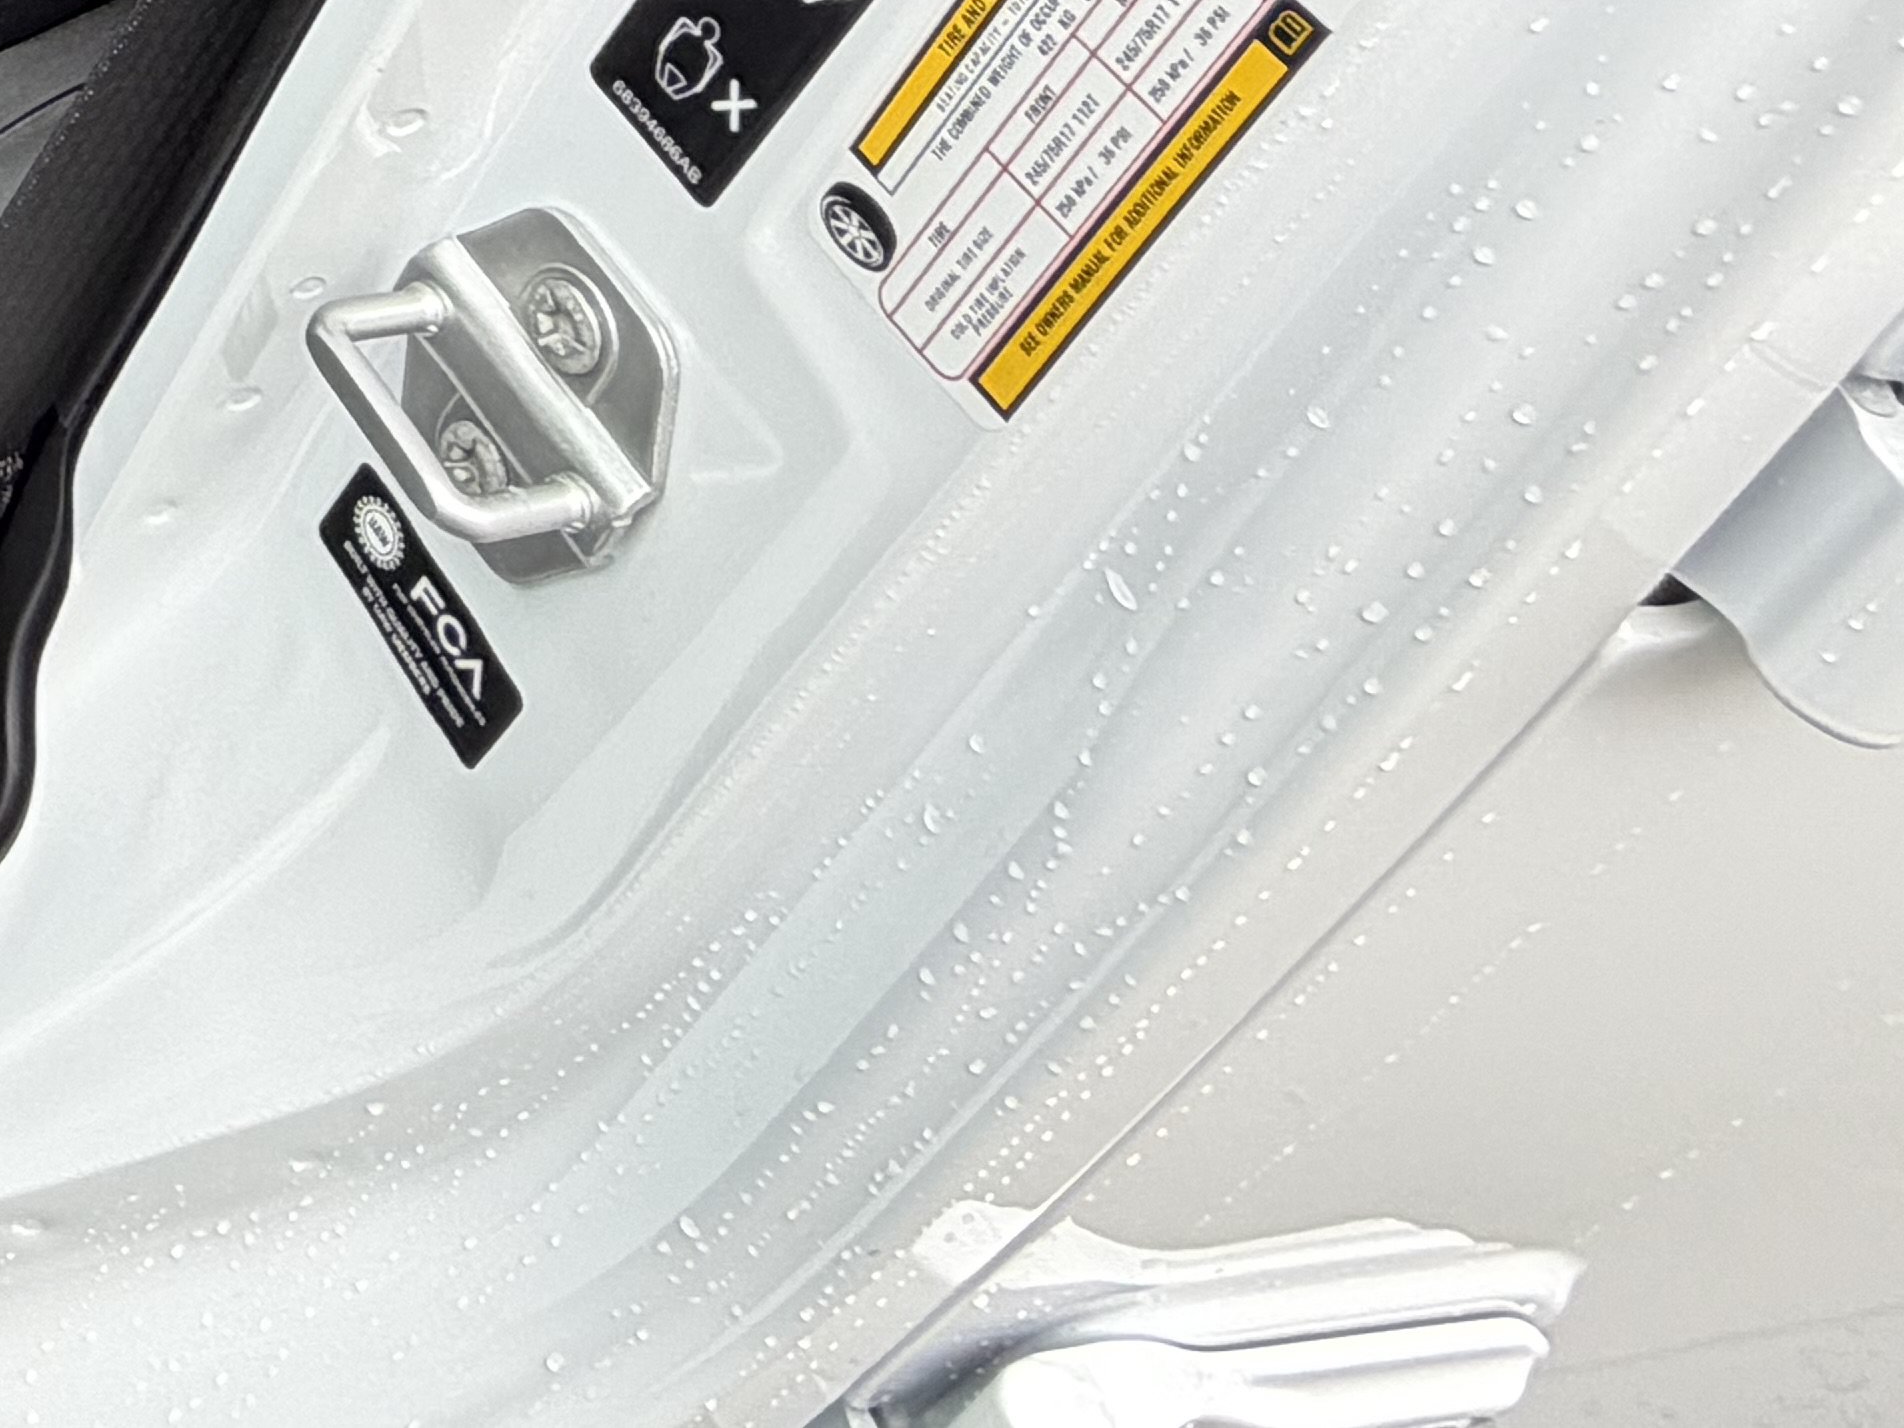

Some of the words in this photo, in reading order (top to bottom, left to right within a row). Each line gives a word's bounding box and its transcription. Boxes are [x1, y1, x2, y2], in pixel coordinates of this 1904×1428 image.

[937, 23, 967, 57] TIRE
[1114, 4, 1170, 72] 245/75R17
[930, 137, 953, 161] THE
[947, 85, 992, 141] COMBINED
[986, 44, 1023, 87] WEIGHT
[1018, 28, 1034, 48] OF
[927, 221, 952, 248] TIRE
[1019, 331, 1042, 357] SEE
[1068, 249, 1111, 294] MANUAL
[1103, 224, 1129, 252] FOR
[1122, 166, 1180, 230] ADDITIONAL
[1172, 90, 1242, 169] INFORMATION
[409, 575, 484, 701] FCA
